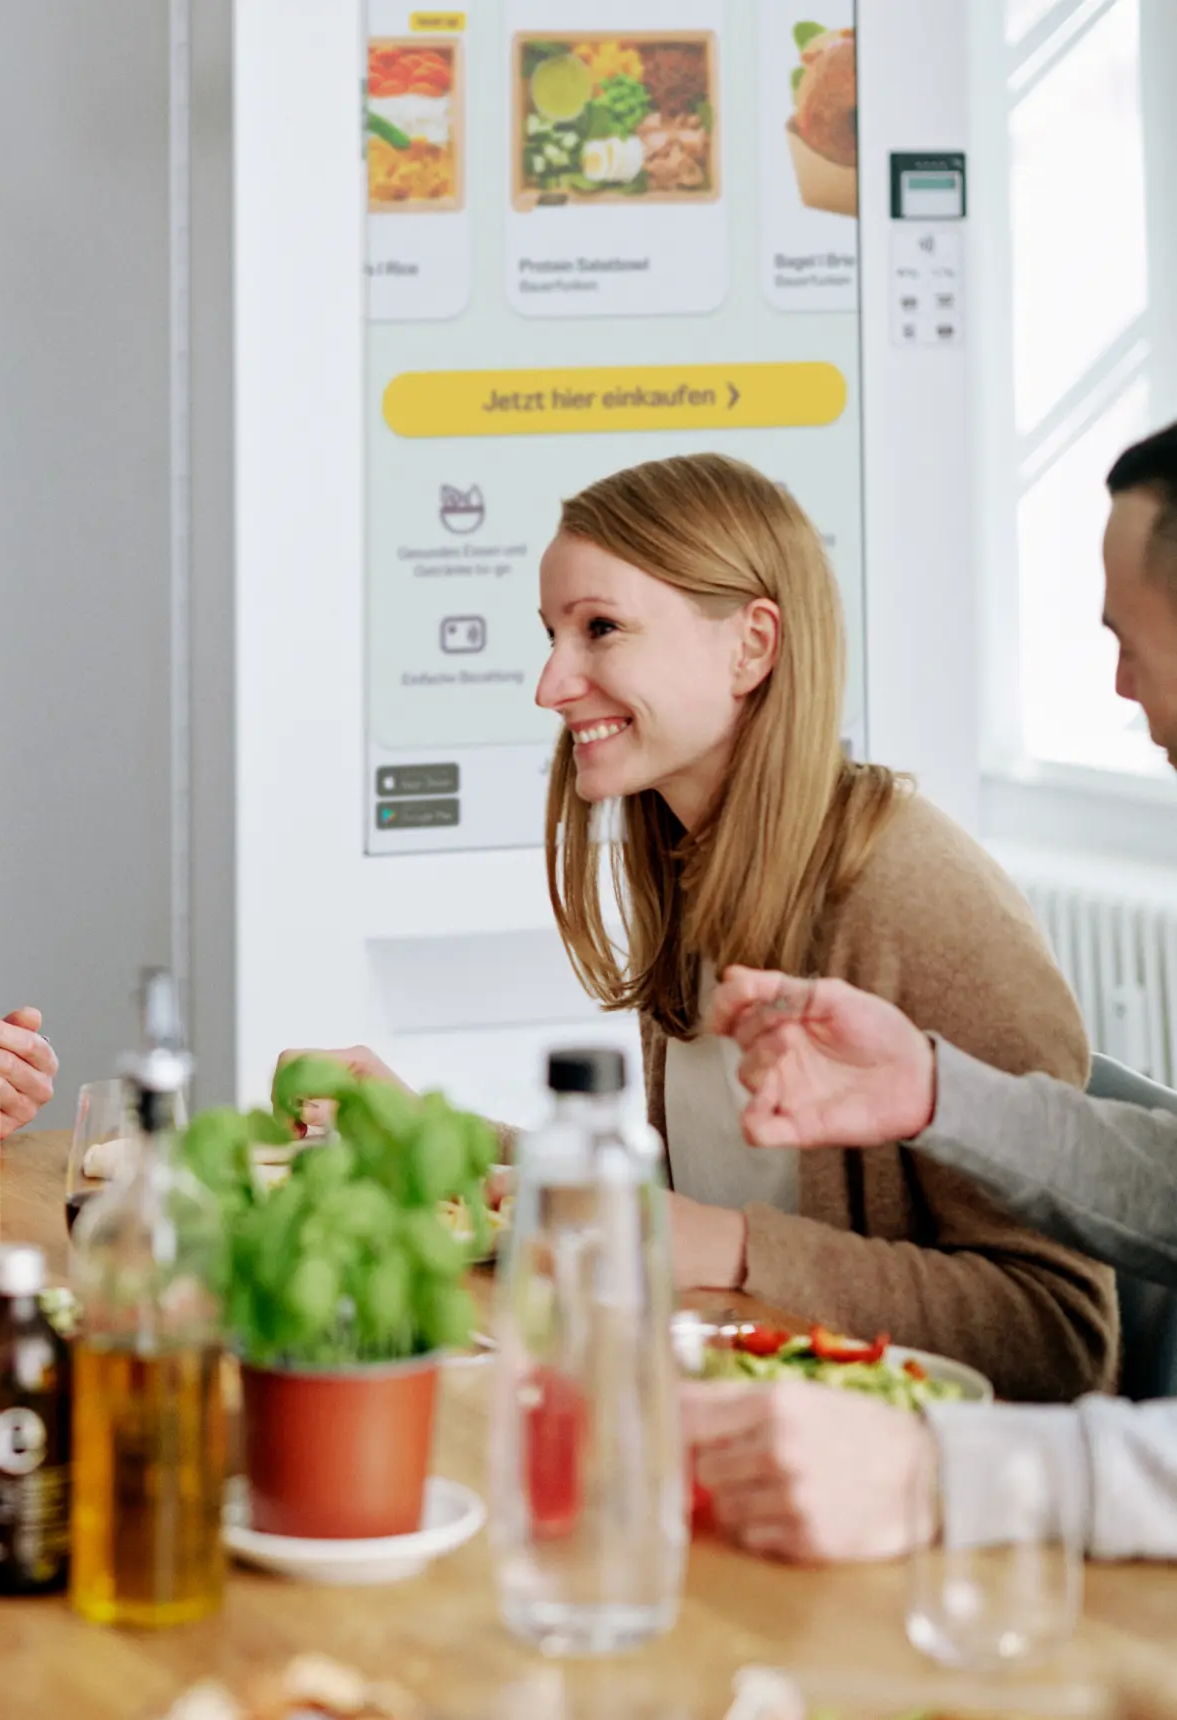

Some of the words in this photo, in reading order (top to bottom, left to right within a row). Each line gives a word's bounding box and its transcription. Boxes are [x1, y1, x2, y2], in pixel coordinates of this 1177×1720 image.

[519, 256, 574, 273] Protein
[482, 389, 546, 413] Jetzt
[552, 387, 598, 410] hier
[602, 384, 716, 408] einkaufen
